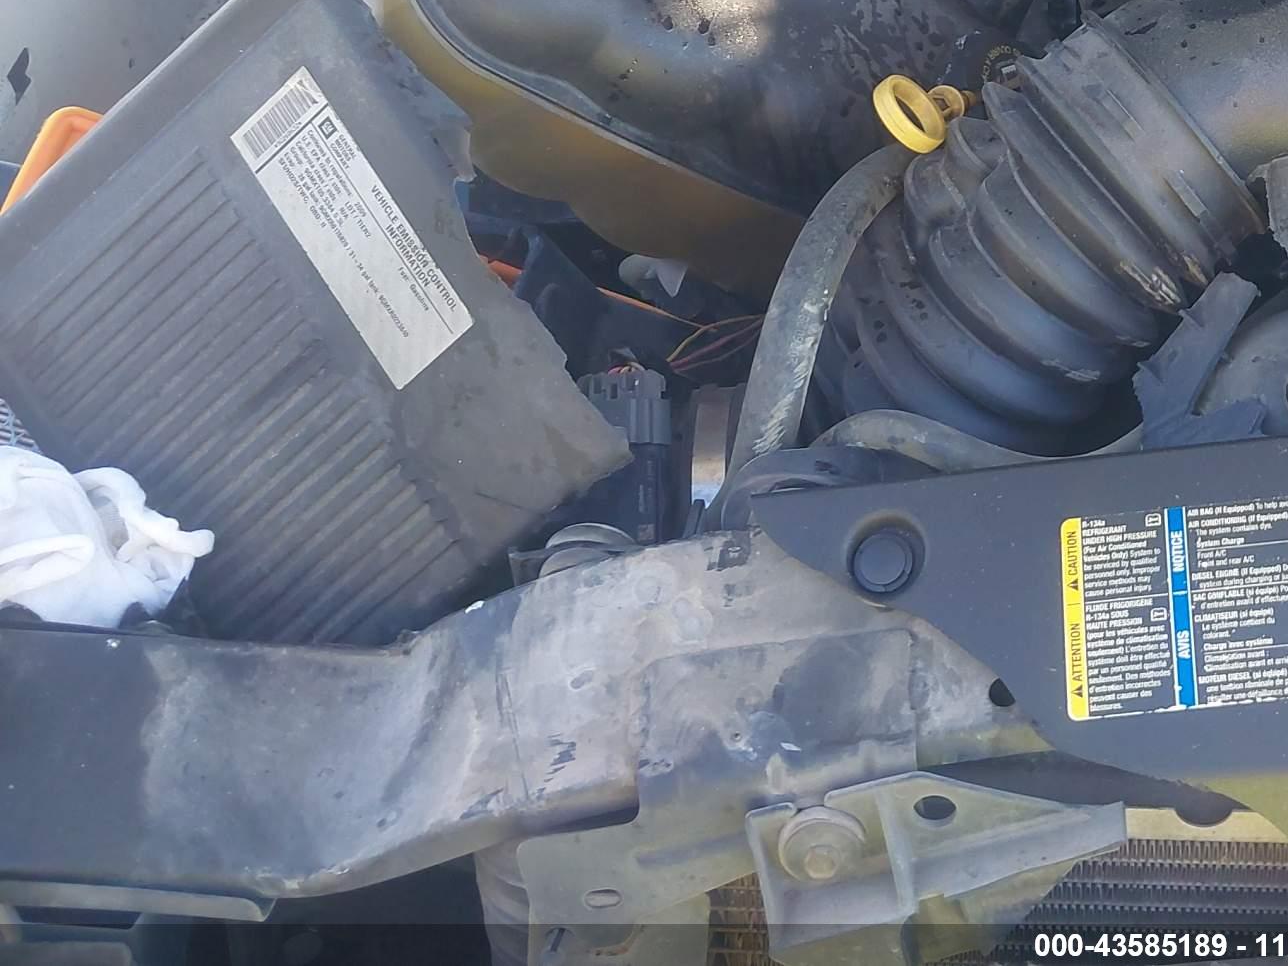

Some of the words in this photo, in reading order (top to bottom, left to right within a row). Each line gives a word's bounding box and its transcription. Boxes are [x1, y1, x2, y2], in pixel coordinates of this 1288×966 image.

[334, 138, 351, 162] MOTORS
[370, 184, 399, 224] VEHICLE
[396, 222, 429, 268] EMISSION
[426, 267, 458, 312] CONTROL
[385, 223, 430, 288] INFORMATION
[1187, 508, 1198, 516] AIR
[1200, 506, 1213, 515] BAG
[1223, 503, 1254, 513] Equipped)
[1256, 502, 1263, 510] To
[1264, 500, 1277, 509] help
[1188, 519, 1199, 529] AIR
[1200, 515, 1246, 527] CONDITIONING
[1255, 511, 1288, 522] Equipped)
[1066, 531, 1077, 575] CAUTION
[1170, 530, 1184, 572] NOTICE
[1196, 538, 1220, 547] System
[1221, 536, 1244, 545] Charge
[1070, 622, 1082, 681] ATTENTION
[1176, 630, 1190, 659] AVIS
